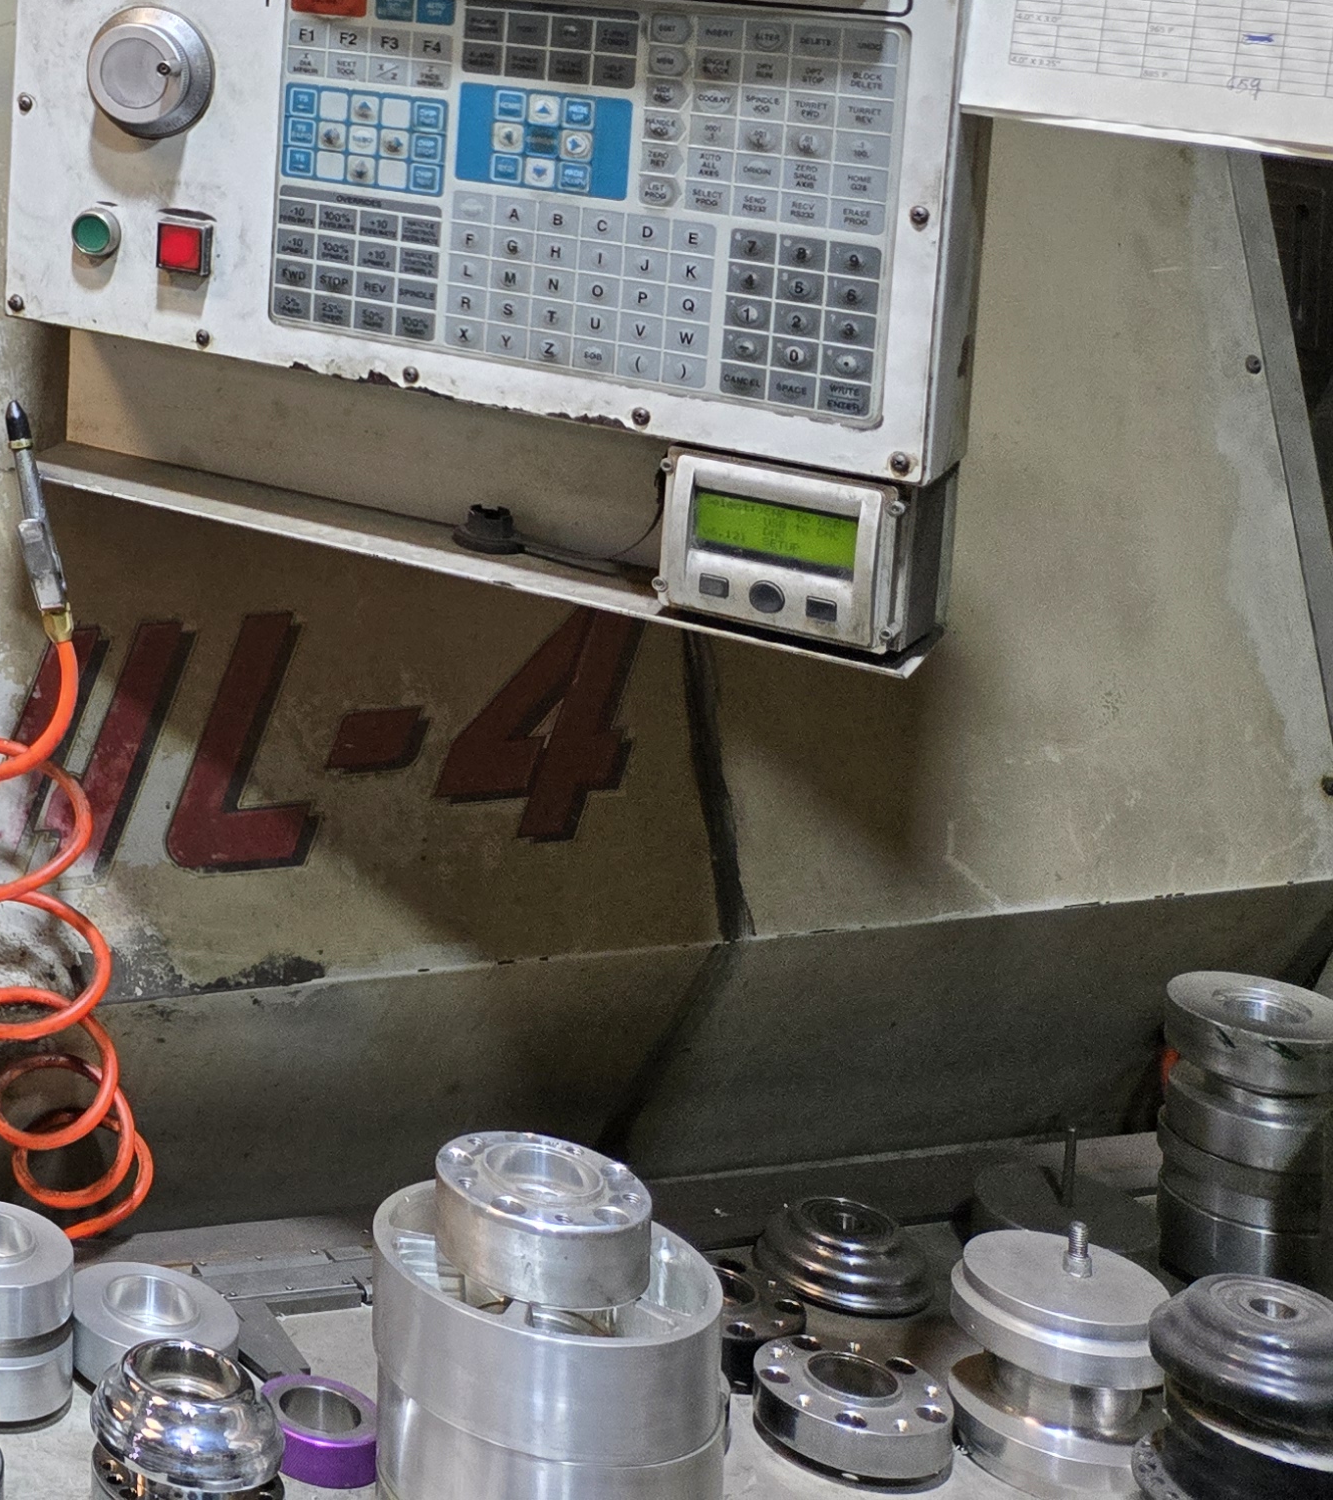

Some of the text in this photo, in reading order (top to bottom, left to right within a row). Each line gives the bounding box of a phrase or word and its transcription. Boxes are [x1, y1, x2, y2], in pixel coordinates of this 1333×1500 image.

[705, 29, 733, 37] INSERT
[755, 32, 780, 41] ALTER
[299, 28, 441, 53] F1 F2 F3 F4
[800, 37, 831, 46] DELETE
[852, 72, 882, 81] BLOCK
[850, 80, 883, 90] DELETE
[745, 95, 780, 105] SPINDLE
[795, 100, 827, 110] TURRET
[848, 106, 882, 116] TURRET
[700, 153, 721, 161] AUTO
[795, 164, 818, 173] ZERO
[847, 175, 872, 184] HOME
[644, 191, 666, 199] PROG
[692, 189, 723, 199] SELECT
[843, 208, 871, 218] ERASE
[509, 208, 699, 245] A B C D E
[843, 217, 868, 226] PROG
[465, 234, 474, 246] F
[507, 240, 518, 252] G
[550, 246, 561, 259] H
[641, 259, 649, 272] J
[686, 265, 697, 278] K
[747, 240, 859, 267] 7 8 9
[282, 268, 435, 300] FWD STOP REV SPINDLE
[744, 274, 857, 301] 4 5 6
[464, 266, 695, 313] L M N O P Q
[460, 297, 694, 345] R S T U V W
[743, 308, 855, 337] 1 2 3
[459, 328, 555, 355] X Y Z
[789, 349, 798, 362] 0
[724, 374, 807, 396] CANCEL SPACE
[829, 383, 859, 396] WRITE
